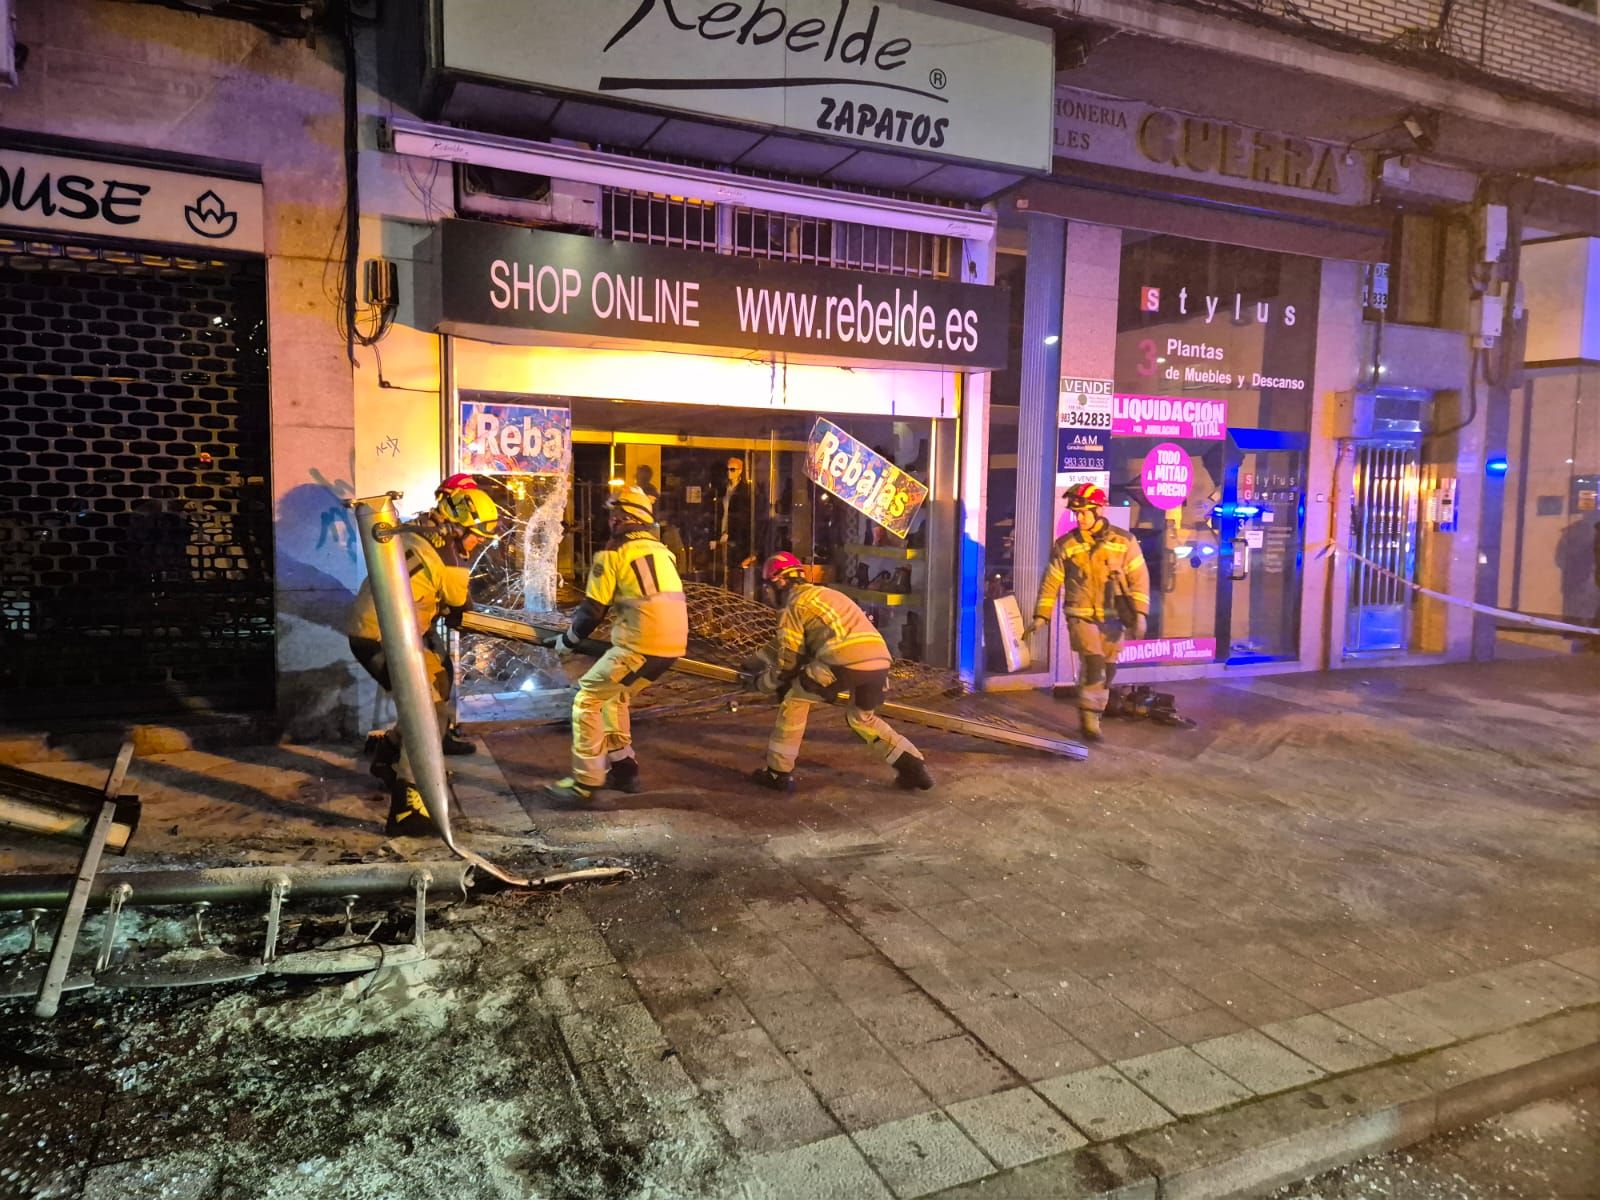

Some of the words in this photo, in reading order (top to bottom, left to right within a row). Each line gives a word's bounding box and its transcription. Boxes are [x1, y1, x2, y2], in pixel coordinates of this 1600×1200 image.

[817, 97, 949, 148] ZAPATOS
[490, 259, 582, 315] SHOP
[592, 271, 700, 328] ONLINE
[736, 284, 979, 352] www.rebelde.es
[1137, 339, 1158, 376] 3
[1167, 338, 1224, 360] Plantas
[1165, 366, 1180, 380] de
[1185, 367, 1232, 384] Muebles
[1237, 374, 1245, 388] y
[1252, 373, 1305, 390] Descanso
[1064, 380, 1112, 395] VENDE
[1070, 411, 1111, 427] 342833
[1113, 397, 1225, 424] LIQUIDACIÓN
[1191, 420, 1220, 438] TOTAL
[1073, 434, 1098, 445] A&M
[1157, 450, 1180, 465] TODO
[815, 431, 909, 517] Rebajas
[1154, 464, 1188, 482] MITAD
[1156, 482, 1187, 497] PRECIO
